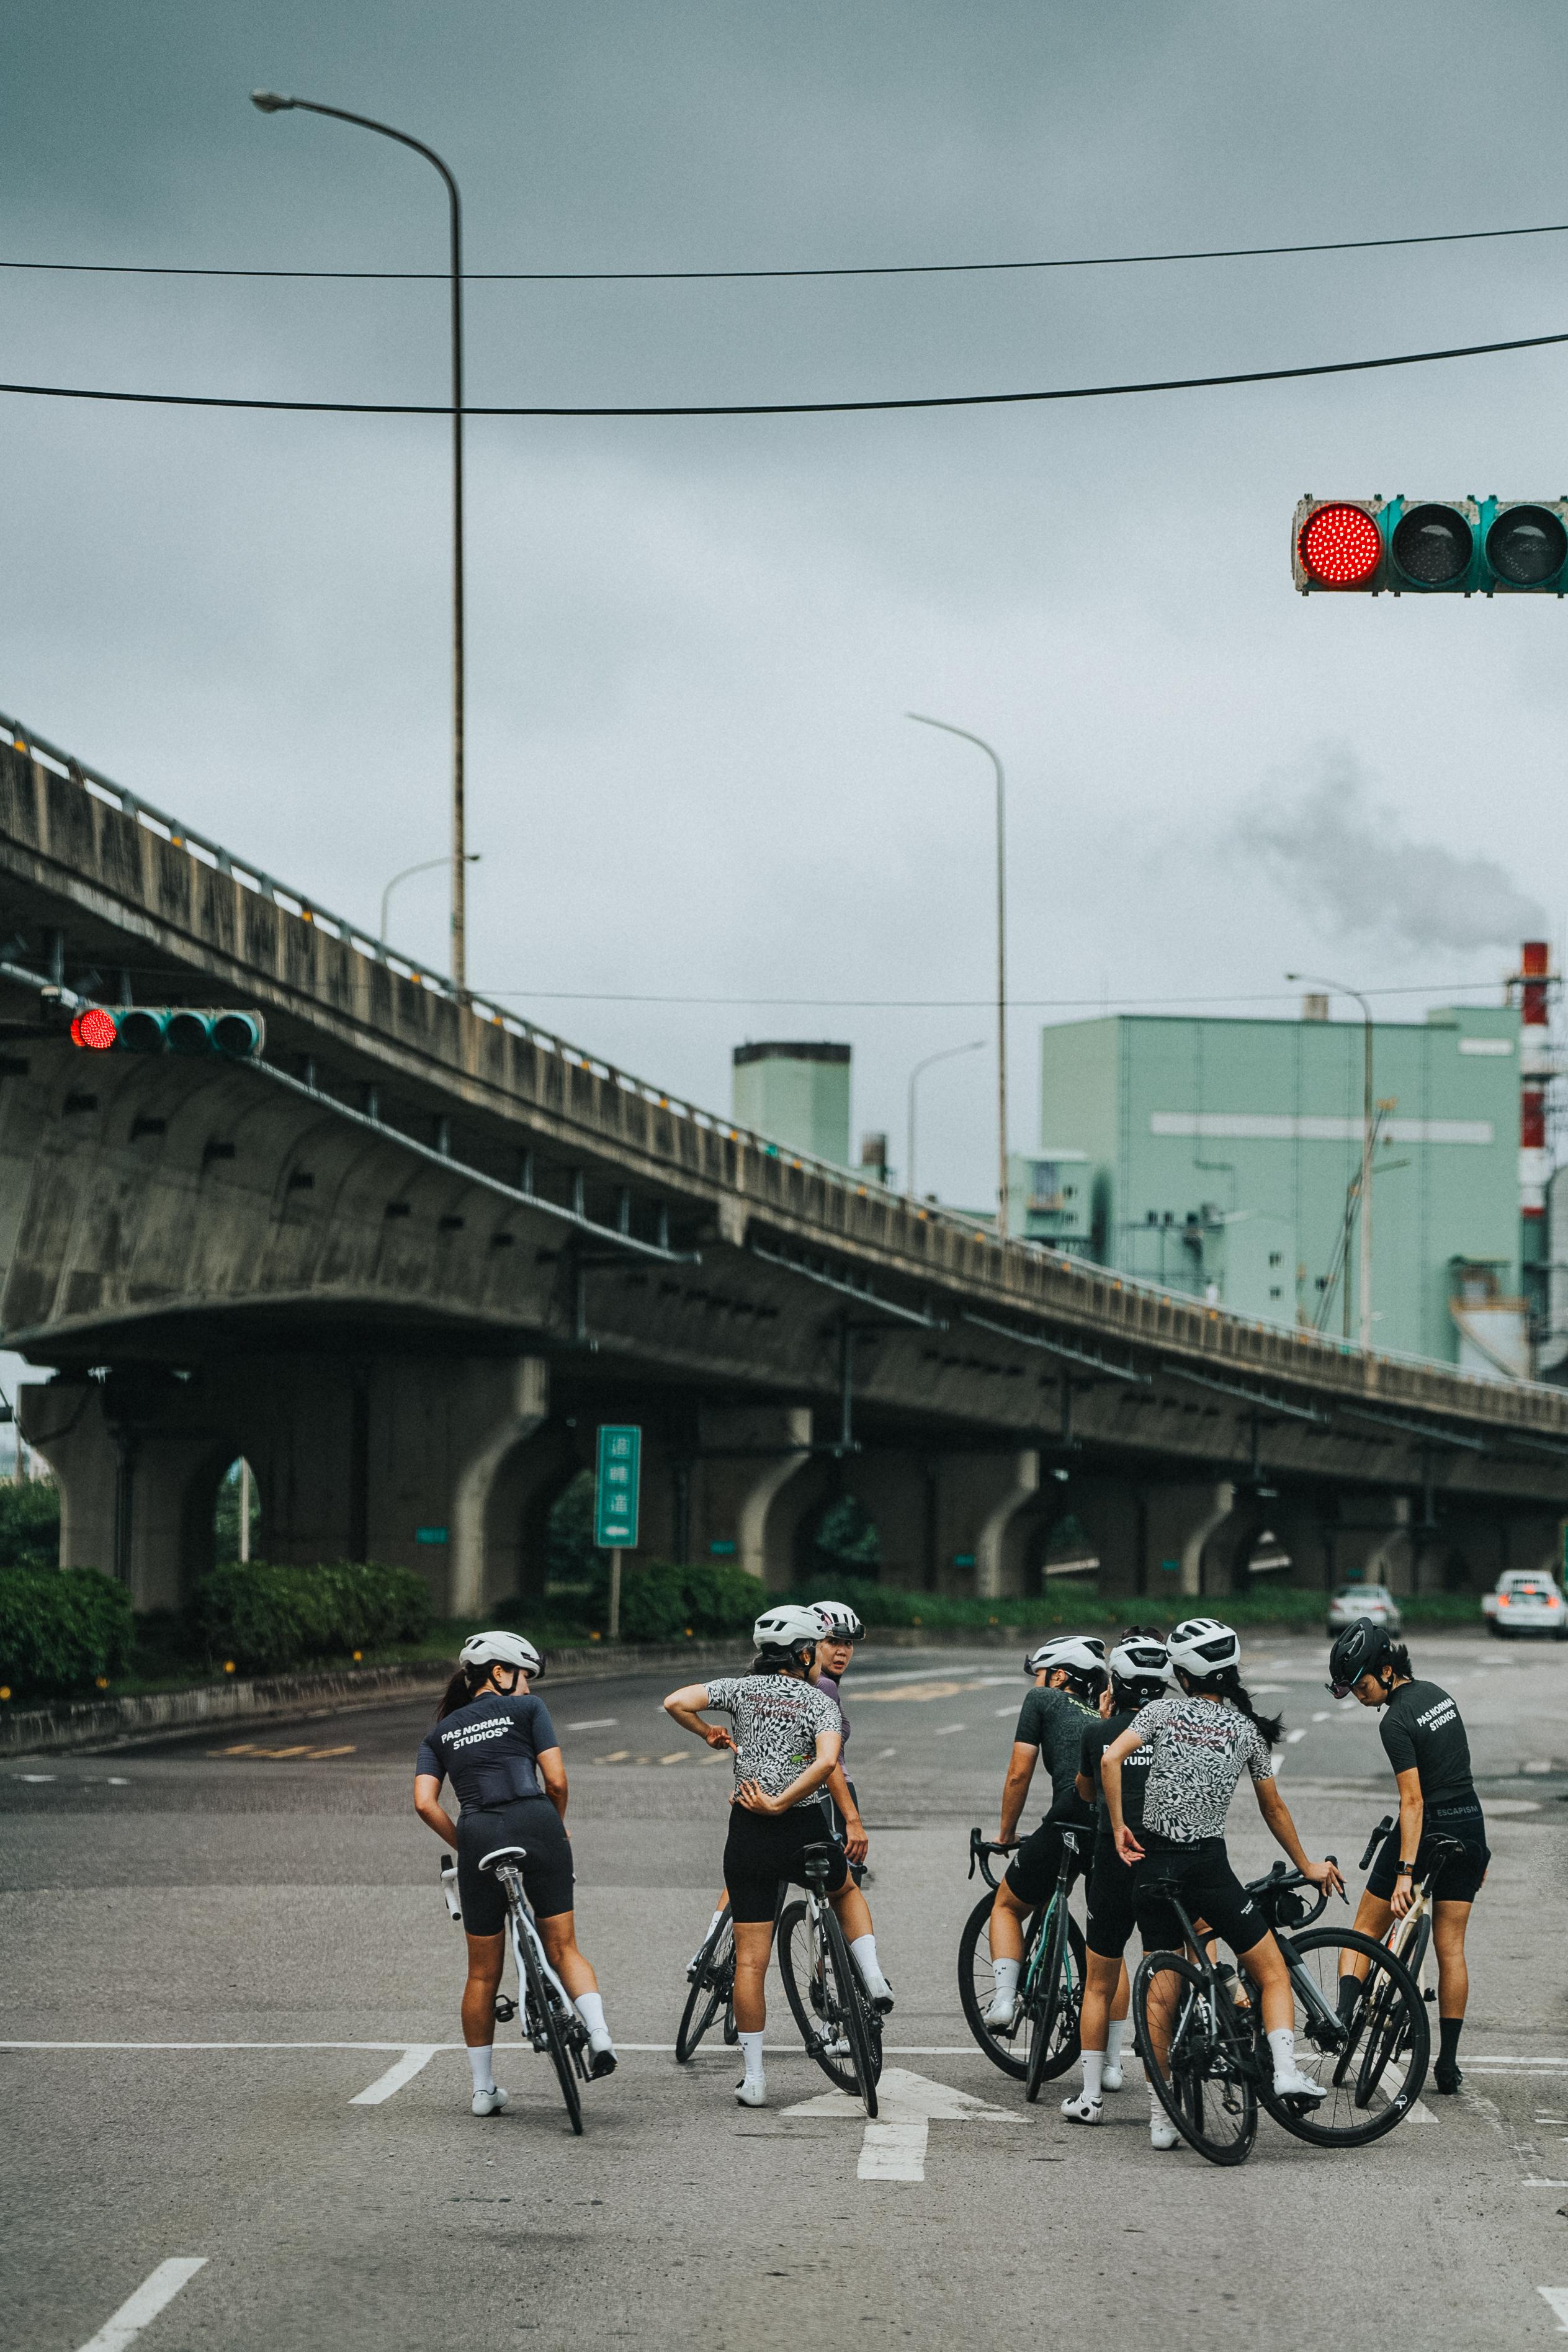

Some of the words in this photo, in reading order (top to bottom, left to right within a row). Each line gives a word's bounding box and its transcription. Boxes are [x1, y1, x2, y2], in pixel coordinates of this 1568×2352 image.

[1417, 1712, 1433, 1726] PAS
[1429, 1697, 1454, 1717] NORMAL
[1429, 1709, 1456, 1731] STUDIOS
[441, 1729, 461, 1744] PAS
[462, 1717, 514, 1735] NORMAL
[1437, 1805, 1479, 1816] ESCAPISM
